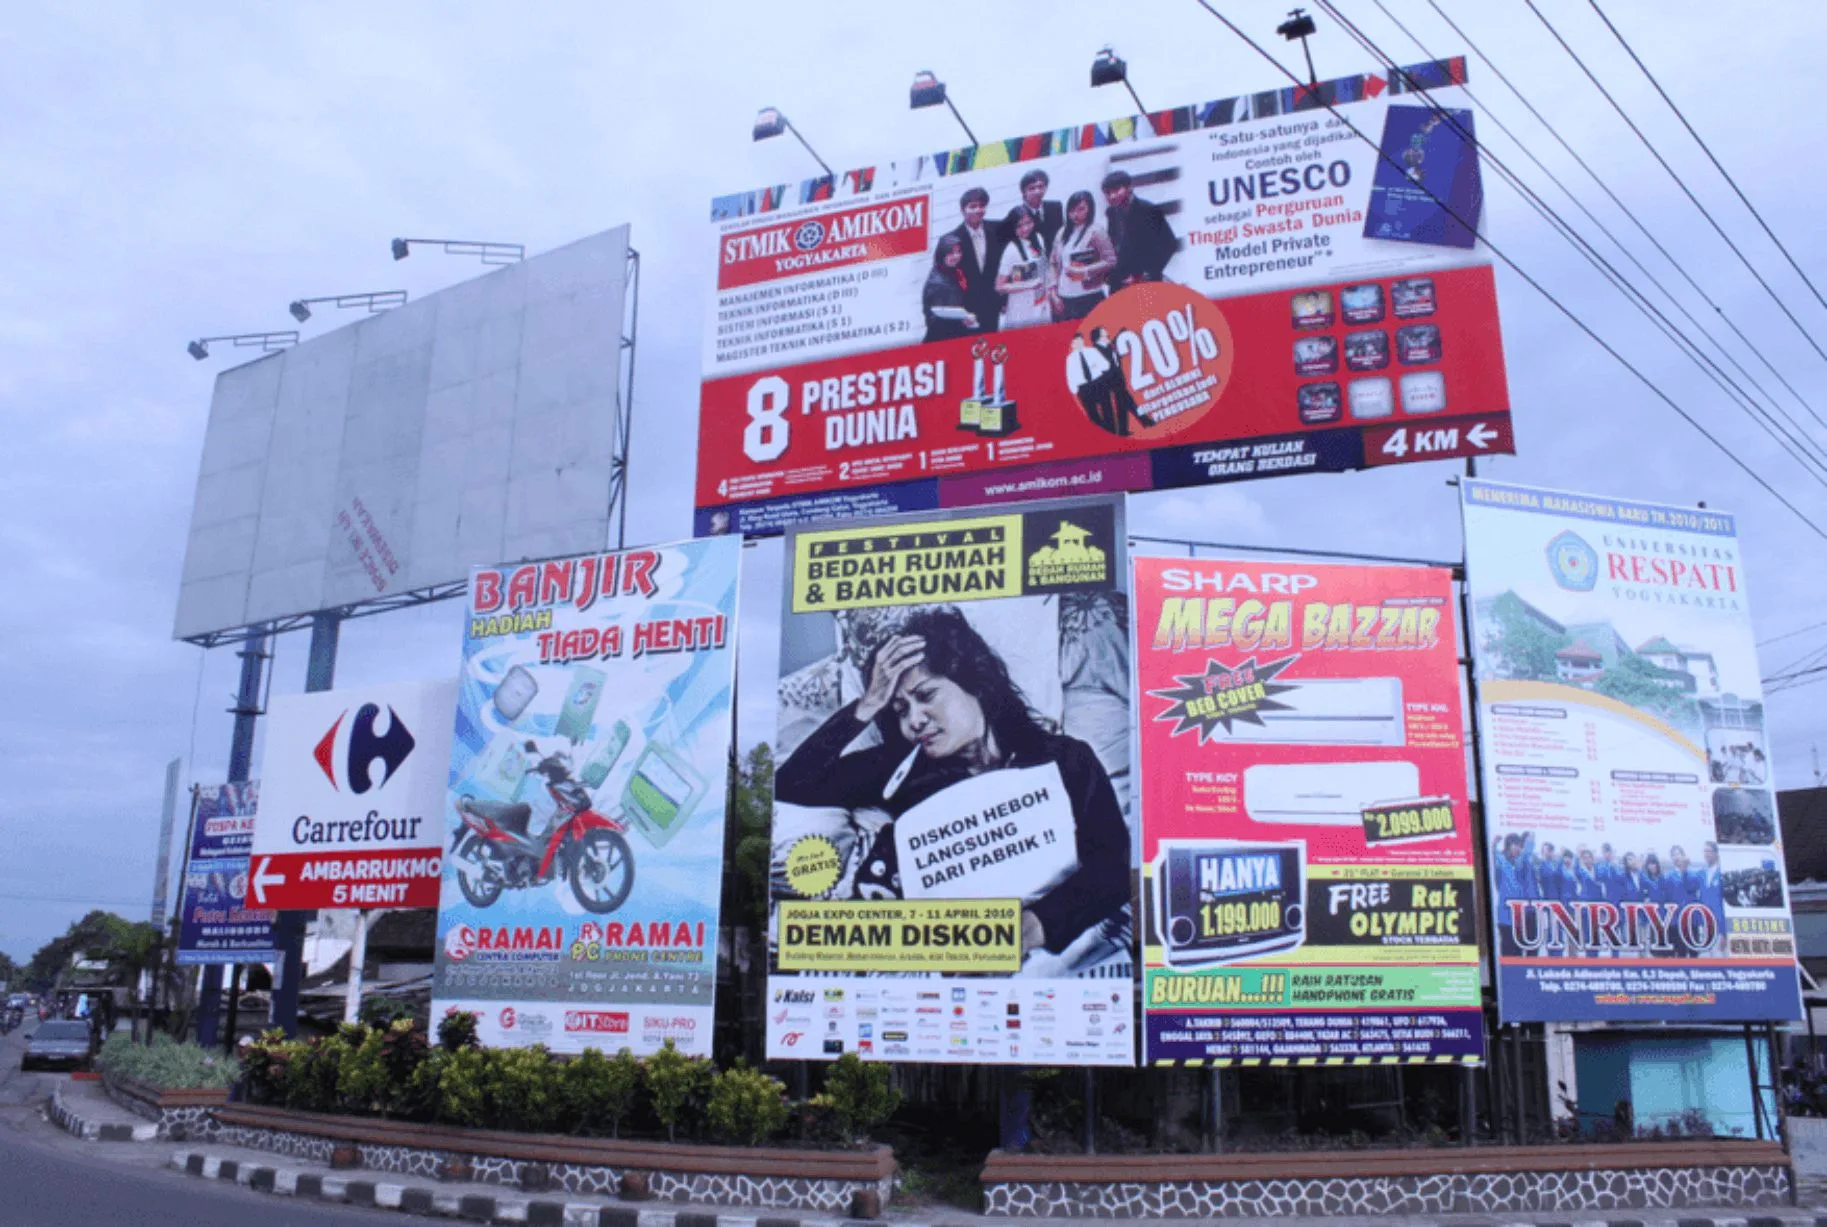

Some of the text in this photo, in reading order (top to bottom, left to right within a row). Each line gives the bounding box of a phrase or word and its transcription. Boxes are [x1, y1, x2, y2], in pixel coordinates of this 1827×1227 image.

[1211, 141, 1301, 163] Indonesia yang
[1244, 149, 1322, 171] Contoh oleh
[1207, 159, 1352, 207] UNESCO
[1203, 193, 1345, 226] sebagai Perguruan
[724, 202, 924, 265] STMIK AMIKOM
[1188, 208, 1363, 246] Tinggi Swasta Dunia
[775, 243, 868, 273] YOGYAKARTA
[1215, 232, 1331, 262] Model Private
[719, 288, 781, 307] MANAJEMEN
[783, 273, 855, 294] INFORMATIKA
[718, 306, 753, 321] TEKNIK
[755, 293, 825, 314] INFORMATIKA
[756, 308, 815, 328] INFORMASI
[754, 322, 824, 342] INFORMATIKA
[770, 340, 807, 354] TEKNIK
[808, 326, 882, 347] INFORMATIKA
[1116, 303, 1218, 390] 20%
[743, 360, 945, 462] 8 PRESTASI
[825, 404, 919, 450] DUNIA
[986, 441, 995, 461] 1
[1192, 447, 1250, 465] TEMPAT
[1382, 428, 1459, 457] 4 KM
[839, 461, 850, 481] 2
[918, 451, 927, 470] 1
[717, 479, 729, 497] 4
[813, 526, 1001, 556] FESTIVAL
[1602, 535, 1734, 561] UNIVERSITAS
[808, 546, 1005, 580] BEDAH RUMAH
[1607, 552, 1738, 593] RESPATI
[474, 550, 662, 613] BANJIR
[805, 569, 1005, 605] & BANGUNAN
[1161, 568, 1319, 594] SHARP
[1612, 587, 1741, 612] YOGYAKARTA
[470, 608, 552, 639] HADIAH
[1151, 597, 1442, 653] MEGA BAZZAR
[537, 614, 727, 664] TIADA HENTI
[1203, 667, 1255, 695] FREE
[1186, 696, 1216, 718] BED
[1217, 679, 1265, 710] COVER
[292, 809, 422, 845] Carrefour
[908, 787, 1050, 851] DISKON HEBOH
[1376, 806, 1453, 837] 2.099.000
[915, 821, 1019, 871] LANGSUNG
[300, 856, 442, 881] AMBARRUKMO
[791, 858, 837, 878] GRATIS
[922, 865, 965, 890] DARI
[970, 838, 1039, 873] PABRIK
[1200, 856, 1281, 892] HANYA
[333, 883, 408, 904] 5 MENIT
[1328, 882, 1458, 915] FREE Rak
[787, 910, 821, 920] JOGJA
[823, 909, 855, 920] EXPO
[926, 909, 941, 920] 11
[944, 909, 980, 920] APRIL
[983, 908, 1015, 919] 2010
[1200, 901, 1280, 936] 1.199.000
[1350, 911, 1460, 936] OLYMPIC
[1506, 900, 1717, 951] UNRIYO
[477, 926, 563, 950] RAMAI
[606, 921, 705, 947] RAMAI
[786, 923, 1016, 948] DEMAM DISKON
[1291, 974, 1384, 986] RAIH RATUSAN
[1292, 989, 1366, 1001] HANDPHONE
